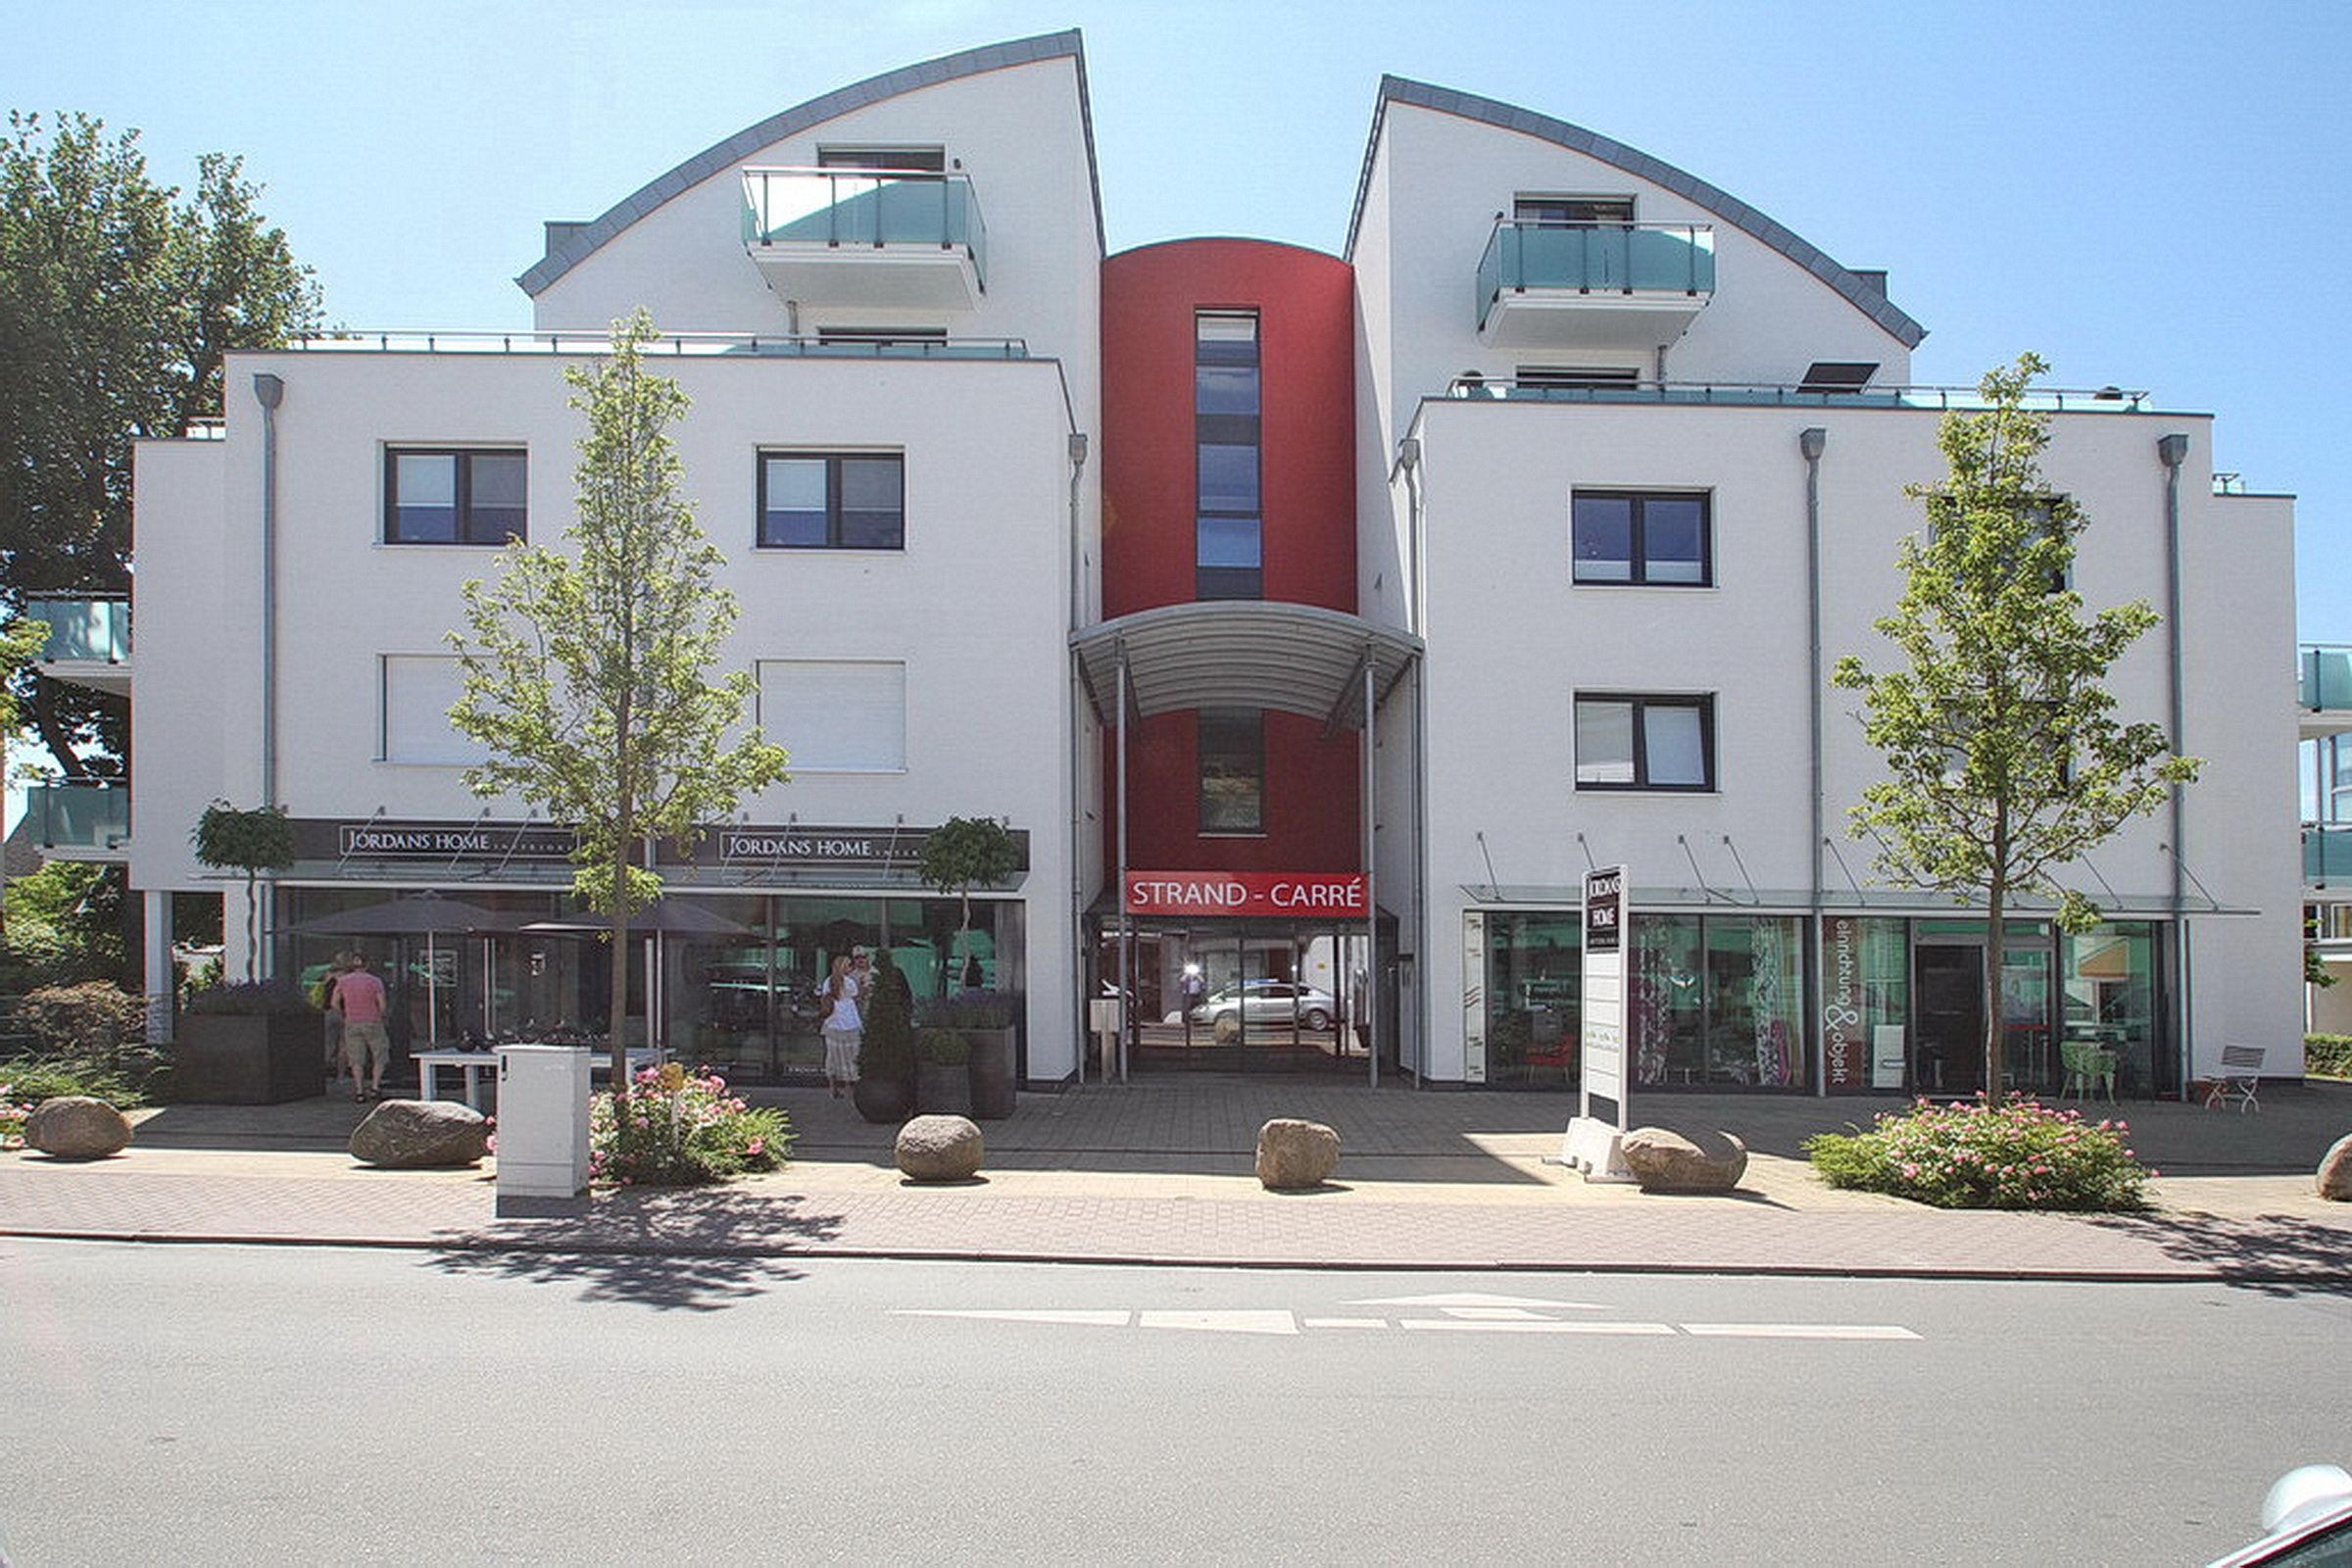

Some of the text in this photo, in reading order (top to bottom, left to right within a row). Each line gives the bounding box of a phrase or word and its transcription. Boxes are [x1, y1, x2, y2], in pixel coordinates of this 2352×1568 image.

[349, 830, 431, 850] JORDANS
[435, 834, 490, 850] HOME
[728, 836, 811, 856] JORDANS
[816, 840, 872, 857] HOME
[1131, 881, 1248, 906] STRAND
[1270, 876, 1362, 907] CARRÉ
[1827, 1032, 1850, 1084] objekt
